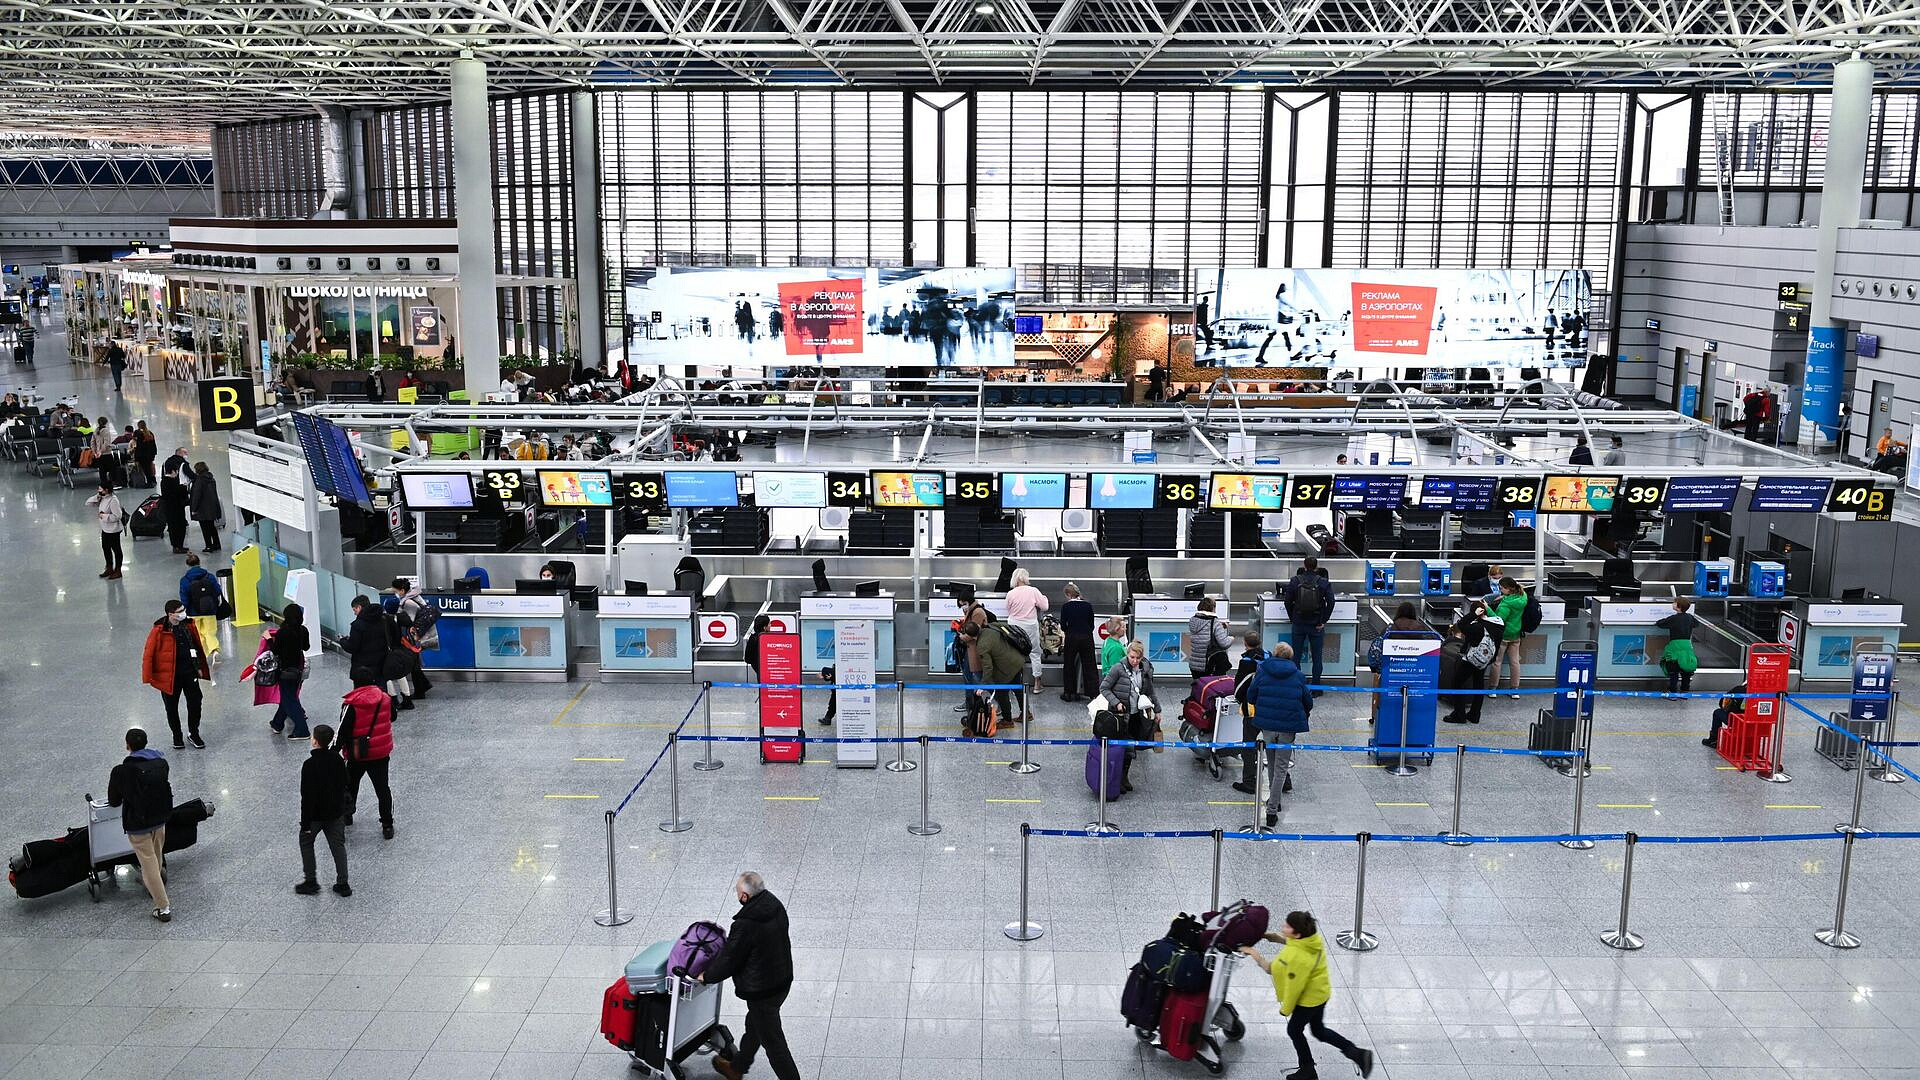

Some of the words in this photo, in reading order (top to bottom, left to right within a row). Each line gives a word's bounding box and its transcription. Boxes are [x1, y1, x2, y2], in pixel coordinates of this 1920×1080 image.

[814, 291, 856, 300] РЕКЛАМА
[1361, 292, 1401, 300] РЕКЛАМА
[1781, 286, 1796, 296] 32
[790, 303, 797, 311] В
[798, 303, 856, 311] АЭРОПОРТАХ
[1361, 303, 1367, 311] В
[1368, 303, 1423, 311] АЭРОПОРТАХ
[830, 338, 855, 346] AMS
[1395, 339, 1419, 347] AMS
[1813, 340, 1836, 349] Track
[212, 386, 243, 424] B
[487, 472, 521, 489] 33
[498, 488, 513, 499] B
[629, 481, 659, 498] 33
[832, 481, 862, 499] 34
[960, 481, 990, 499] 35
[1165, 483, 1196, 500] 36
[1296, 484, 1326, 501] 37
[1502, 486, 1533, 503] 38
[1627, 486, 1658, 503] 39
[1836, 488, 1868, 505] 40
[1867, 491, 1885, 512] B
[438, 598, 469, 609] Utair
